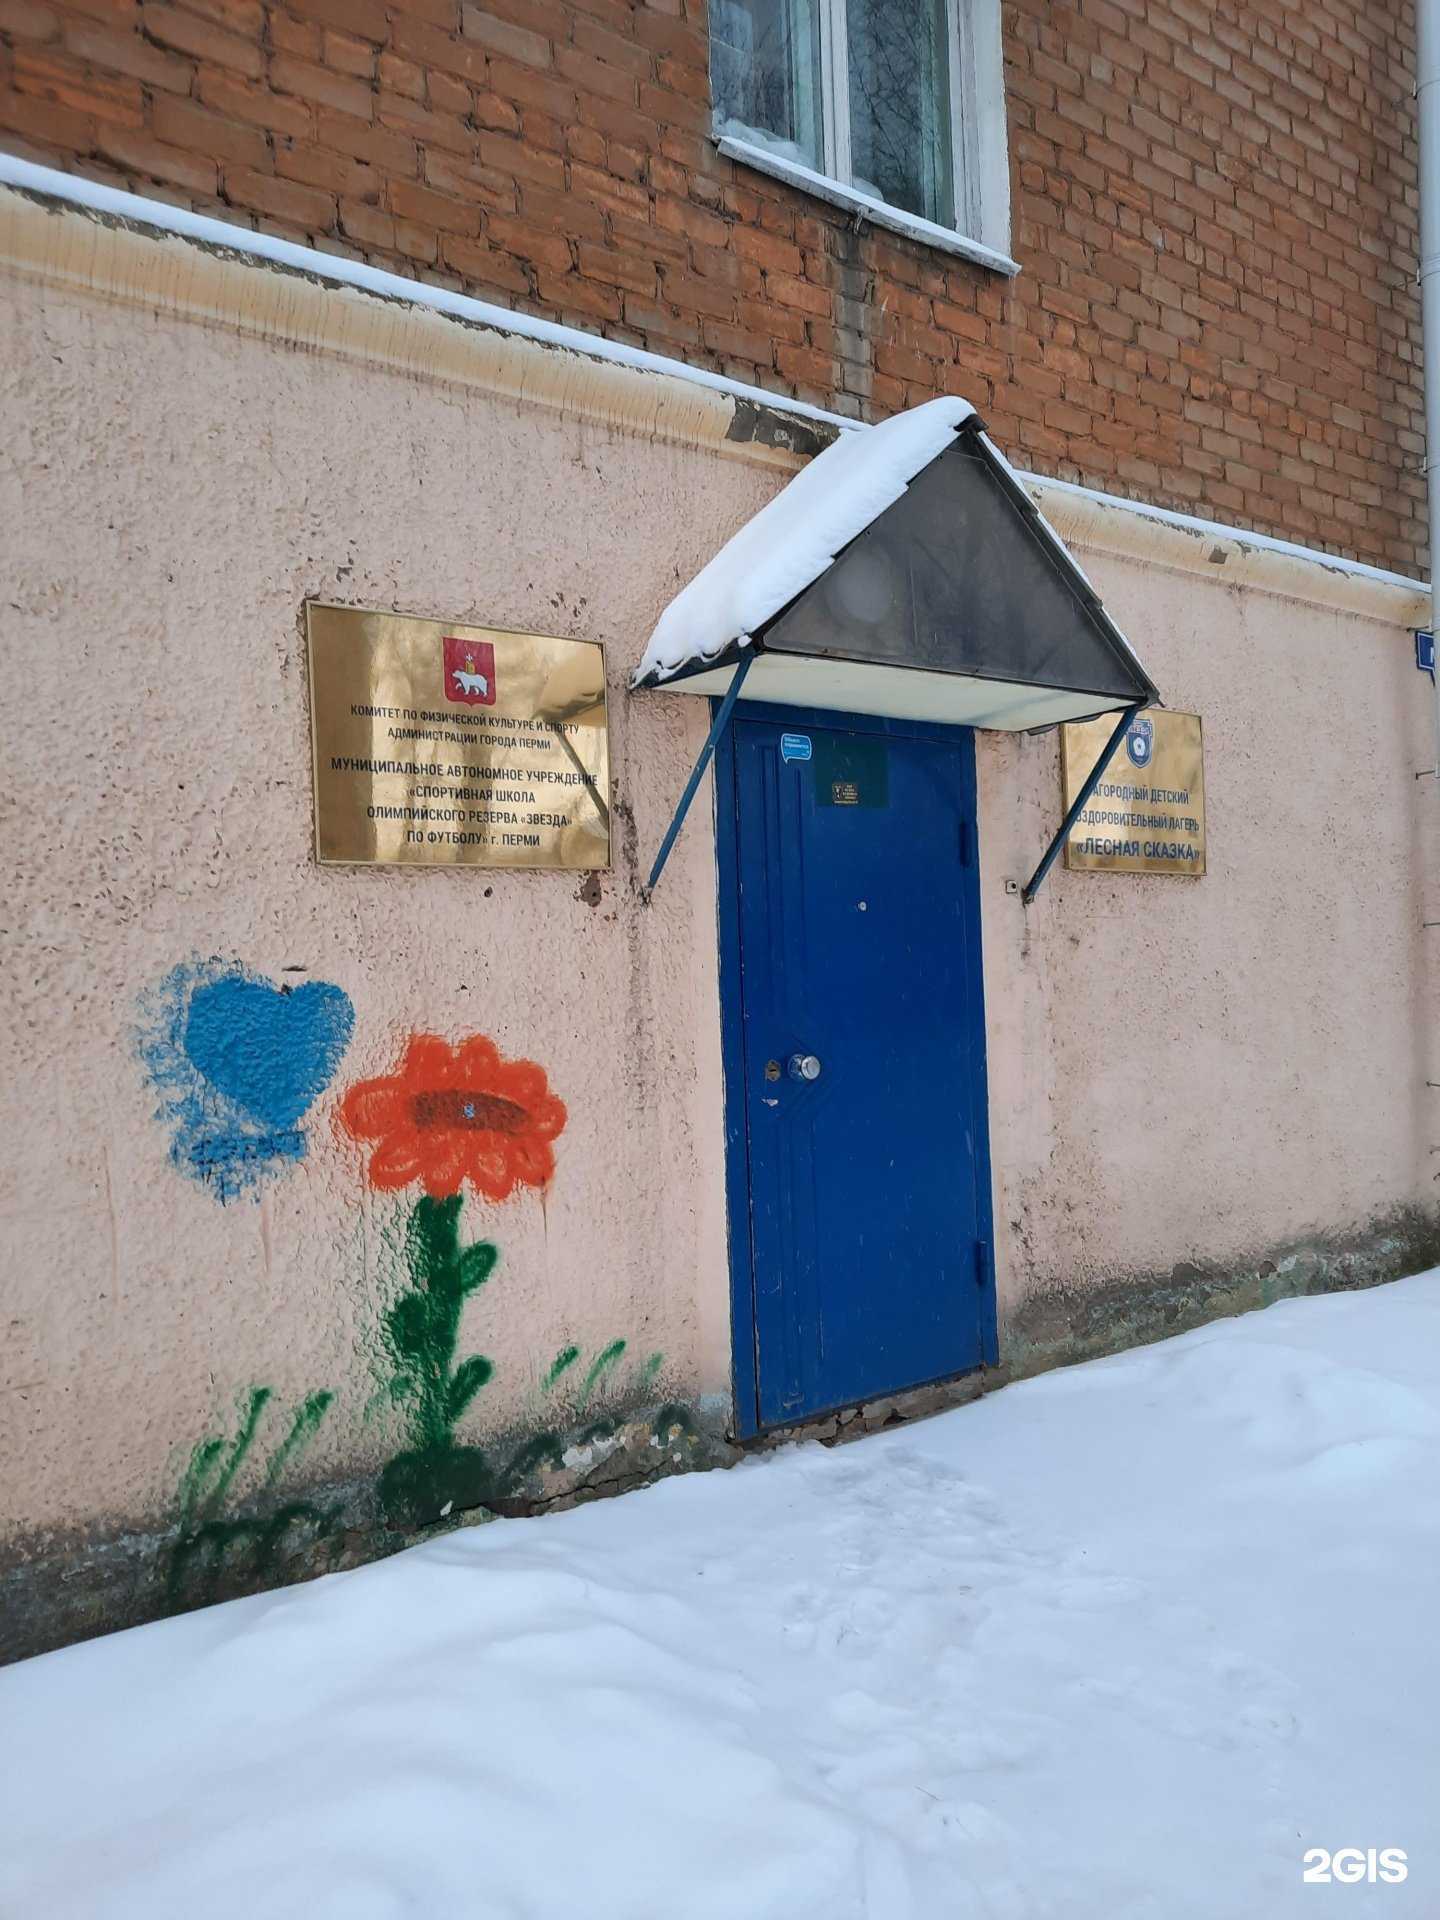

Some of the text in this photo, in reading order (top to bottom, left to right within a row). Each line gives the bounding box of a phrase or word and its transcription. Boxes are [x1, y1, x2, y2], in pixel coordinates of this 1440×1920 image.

[350, 703, 579, 735] КОМИТЕТ ПО ФИЗИЧЕСКОЙ КУЛЬТУРЕ И СПОРТУ
[387, 727, 551, 750] АДМИНИСТРАЦИИ ГОРОДА ПЕРМИ
[331, 757, 599, 787] МУНИЦИПАЛЬНОЕ АВТОНОМНОЕ УЧРЕЖДЕНИЕ
[409, 785, 536, 804] «СПОРТИВНАЯ ШКОЛА
[1092, 784, 1189, 805] АГОРОДНЫЙ ДЕТСКИЙ
[367, 804, 573, 829] ОЛИМПИЙСКОГО РЕЗЕРВА «ЗВЕЗДА»
[1169, 816, 1200, 832] ЛАГЕРЬ
[407, 830, 424, 843] ПО
[427, 831, 488, 846] ФУТБОЛУ»
[502, 834, 541, 847] ПЕРМИ
[1076, 837, 1200, 860] «ЛЕСНАЯ СКАЗКА»
